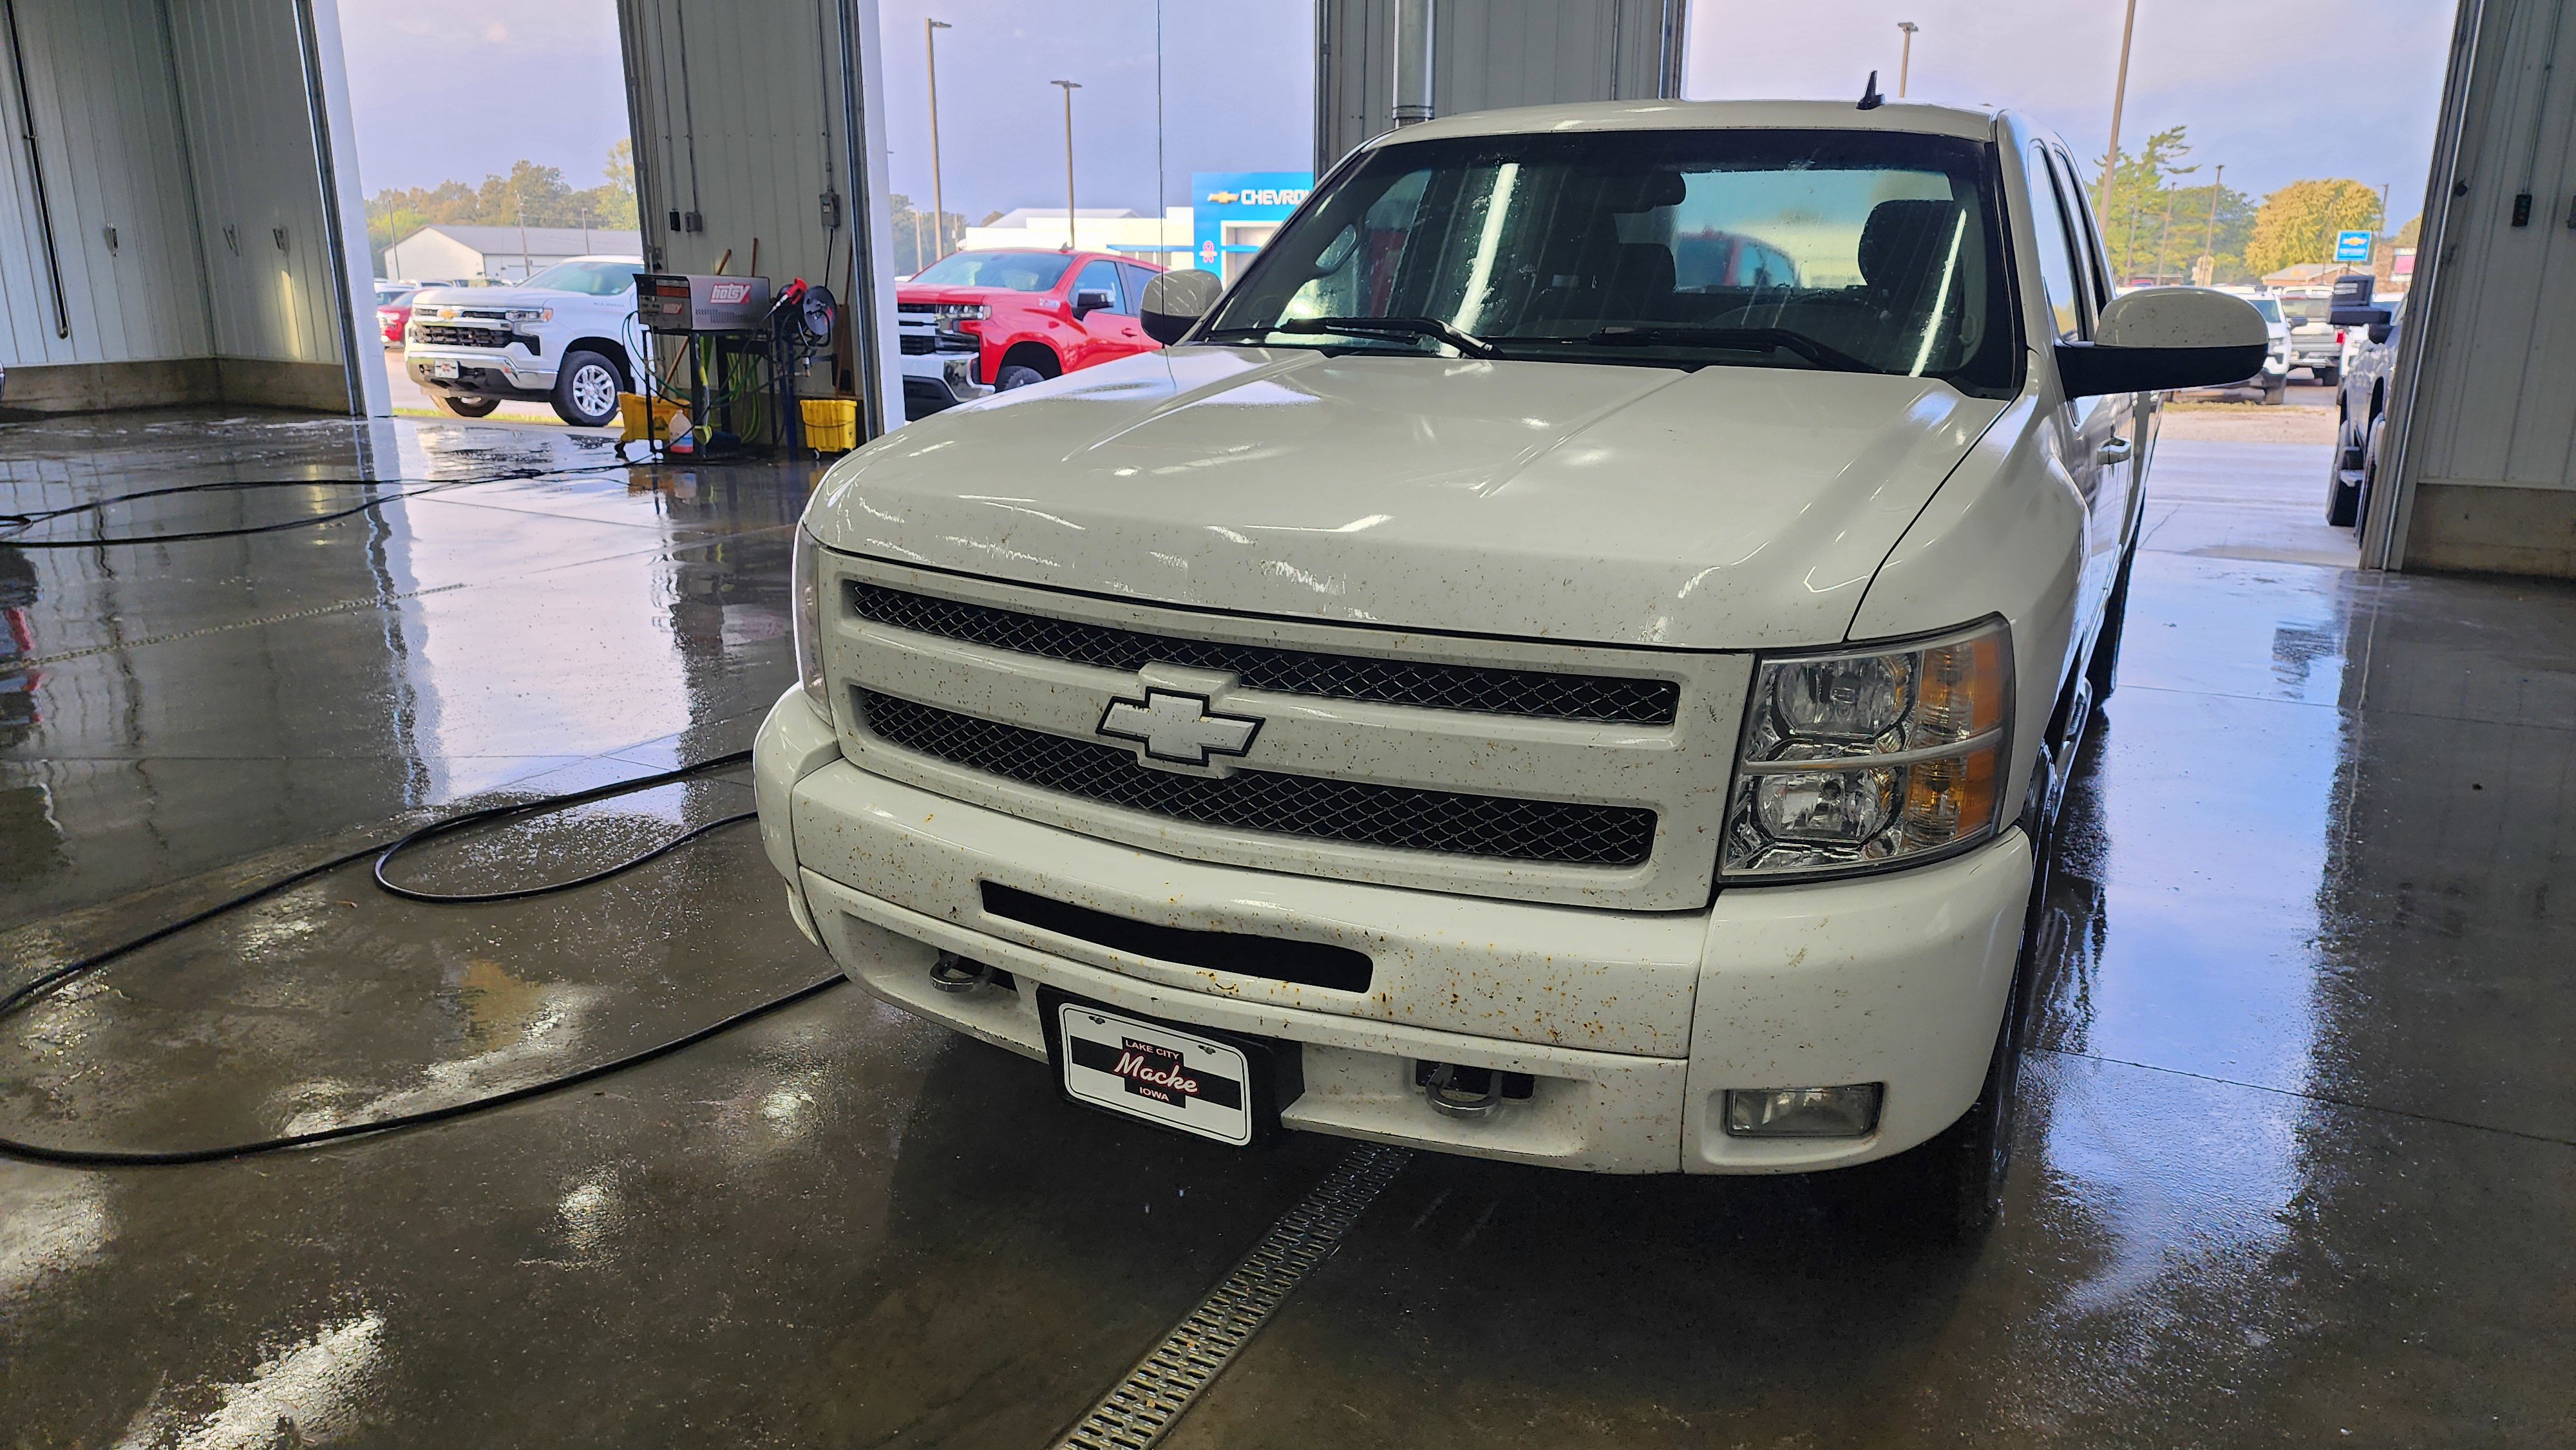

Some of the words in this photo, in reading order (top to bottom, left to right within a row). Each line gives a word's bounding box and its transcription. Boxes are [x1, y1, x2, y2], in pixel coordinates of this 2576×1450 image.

[1125, 1039, 1154, 1053] LAKE
[1156, 1048, 1180, 1060] CITY
[1113, 1051, 1198, 1093] Macke
[1139, 1086, 1170, 1102] IOWA
